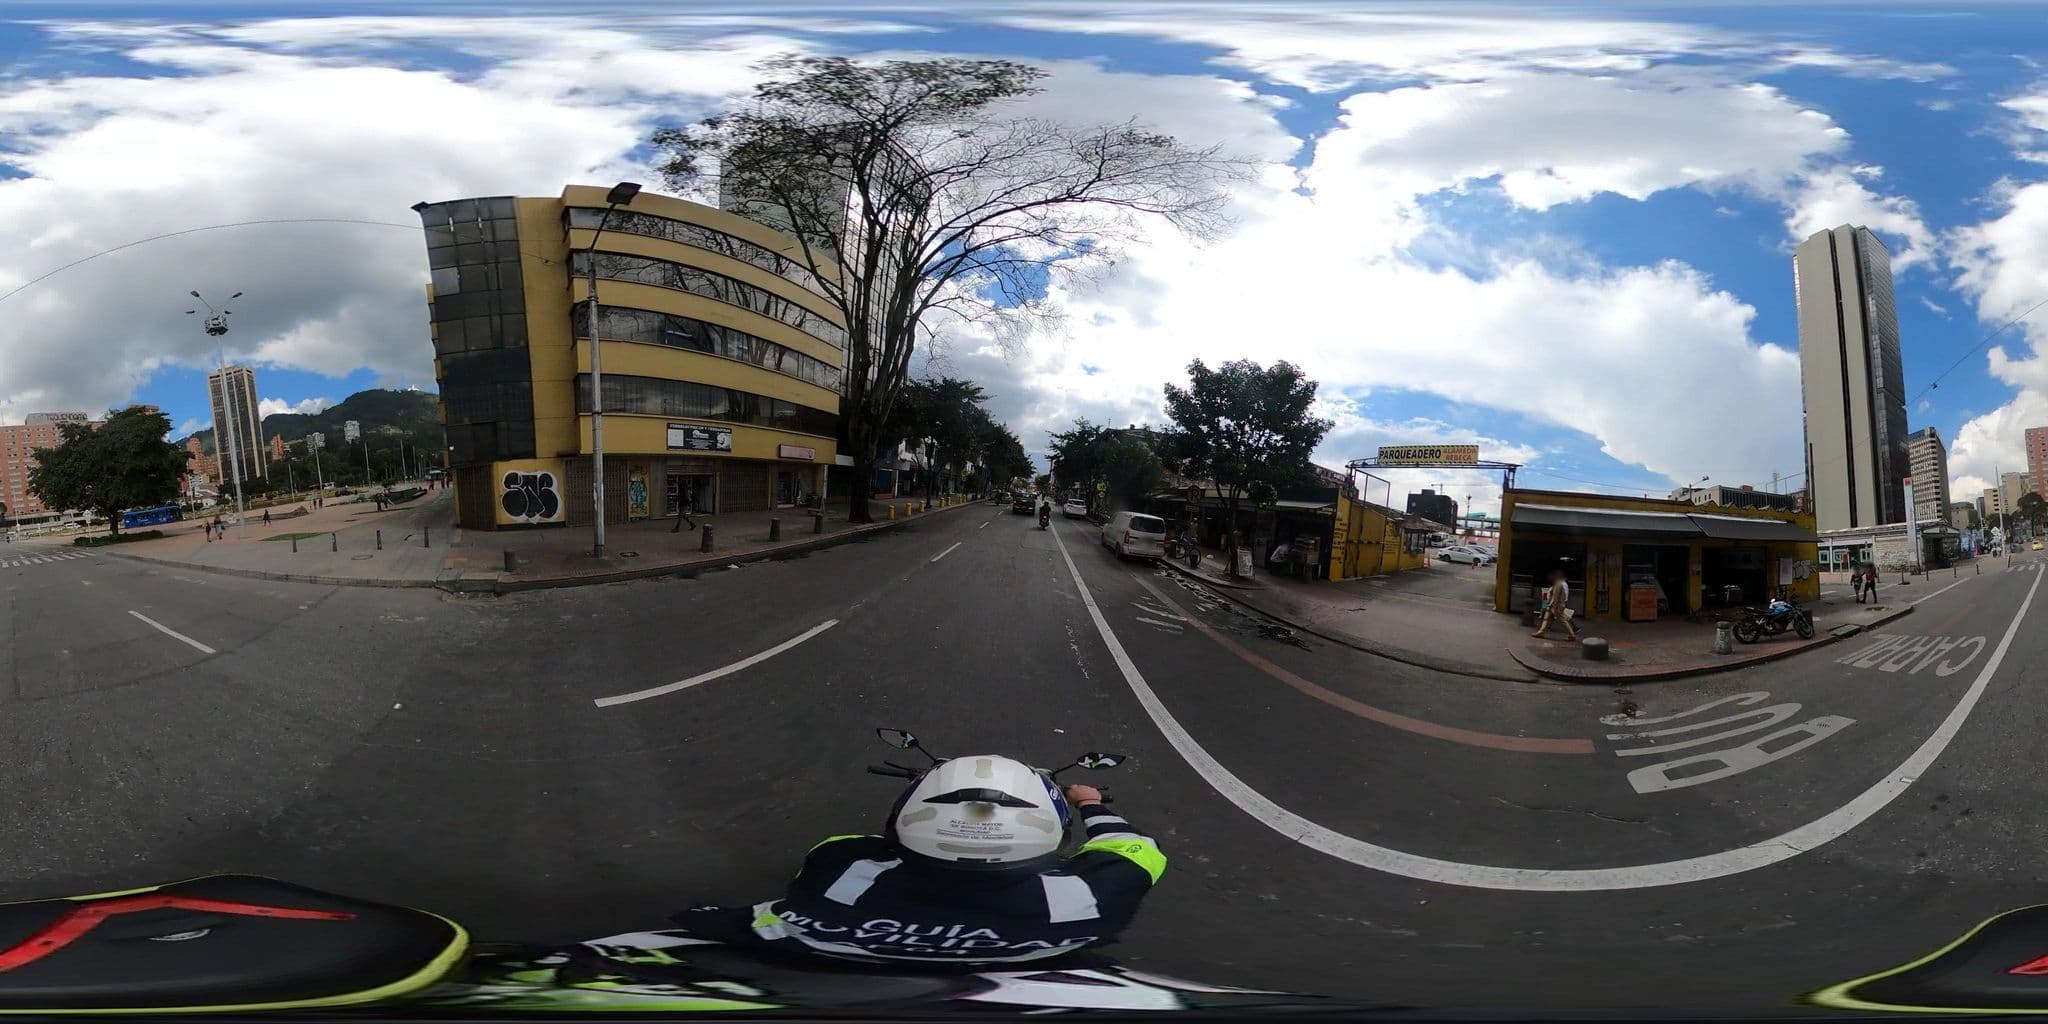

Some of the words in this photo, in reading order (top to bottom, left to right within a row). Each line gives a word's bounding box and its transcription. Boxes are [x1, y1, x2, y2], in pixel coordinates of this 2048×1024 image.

[1379, 449, 1441, 460] PARQUEADERO
[1836, 633, 1986, 677] CARRIL
[1599, 691, 1858, 794] BUS
